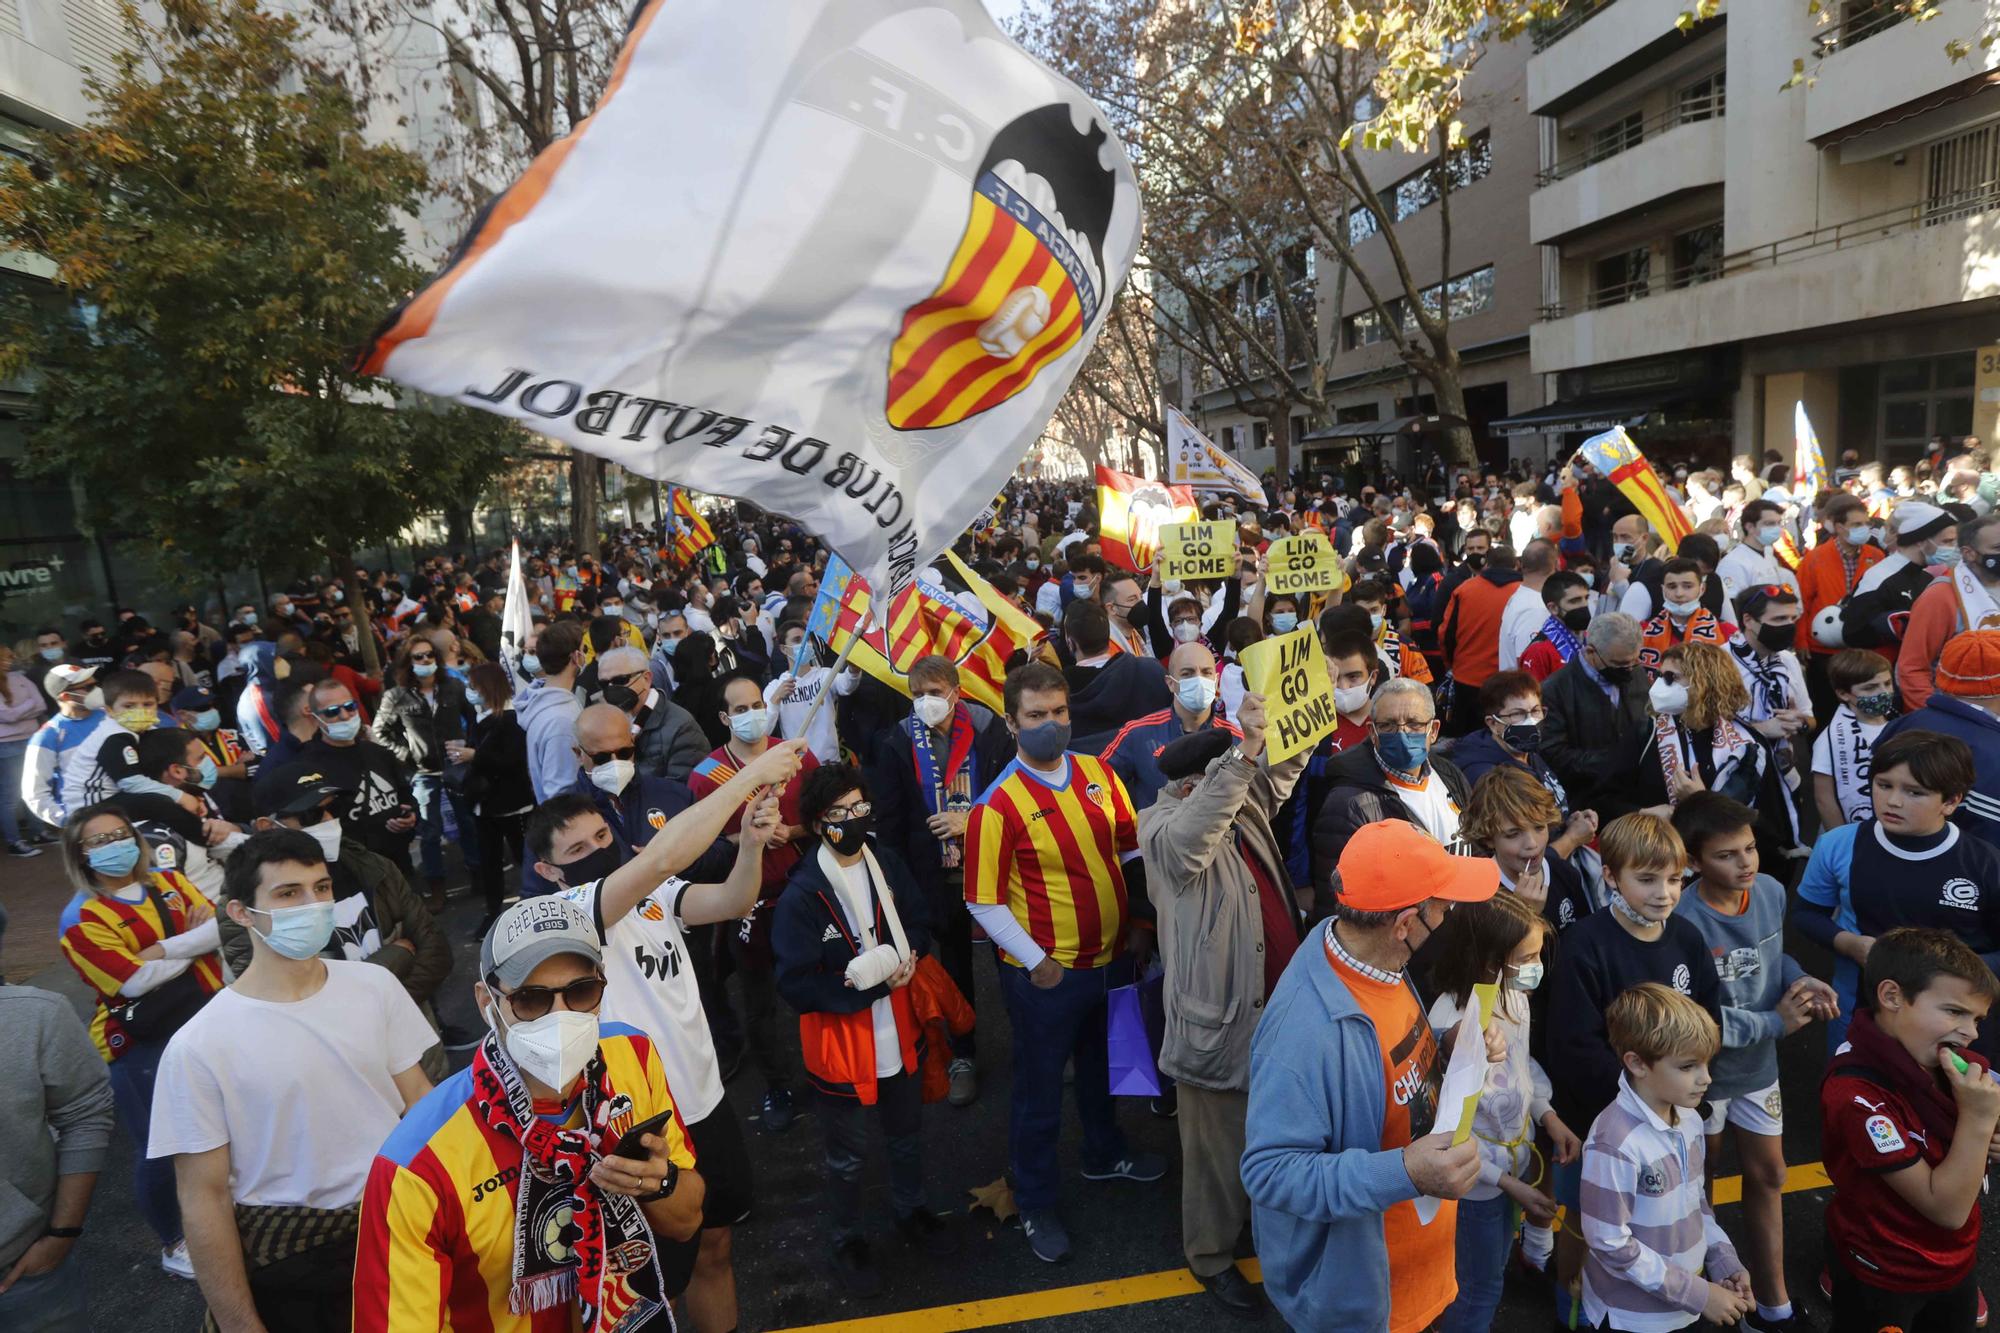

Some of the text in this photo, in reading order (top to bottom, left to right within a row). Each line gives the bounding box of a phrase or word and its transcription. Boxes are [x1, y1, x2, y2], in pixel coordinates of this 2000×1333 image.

[1179, 525, 1213, 541] LIM
[1183, 542, 1212, 557] GO
[1286, 539, 1318, 556] LIM
[1169, 558, 1225, 576] HOME
[1288, 556, 1316, 571] GO
[1275, 571, 1331, 590] HOME
[1280, 633, 1311, 674] LIM
[1281, 668, 1309, 705] GO
[1276, 692, 1335, 750] HOME
[1938, 899, 1979, 911] ESCLAVAS
[507, 901, 589, 943] CHELSEA FC
[539, 920, 564, 931] 1905
[1877, 1138, 1901, 1149] LaLiga
